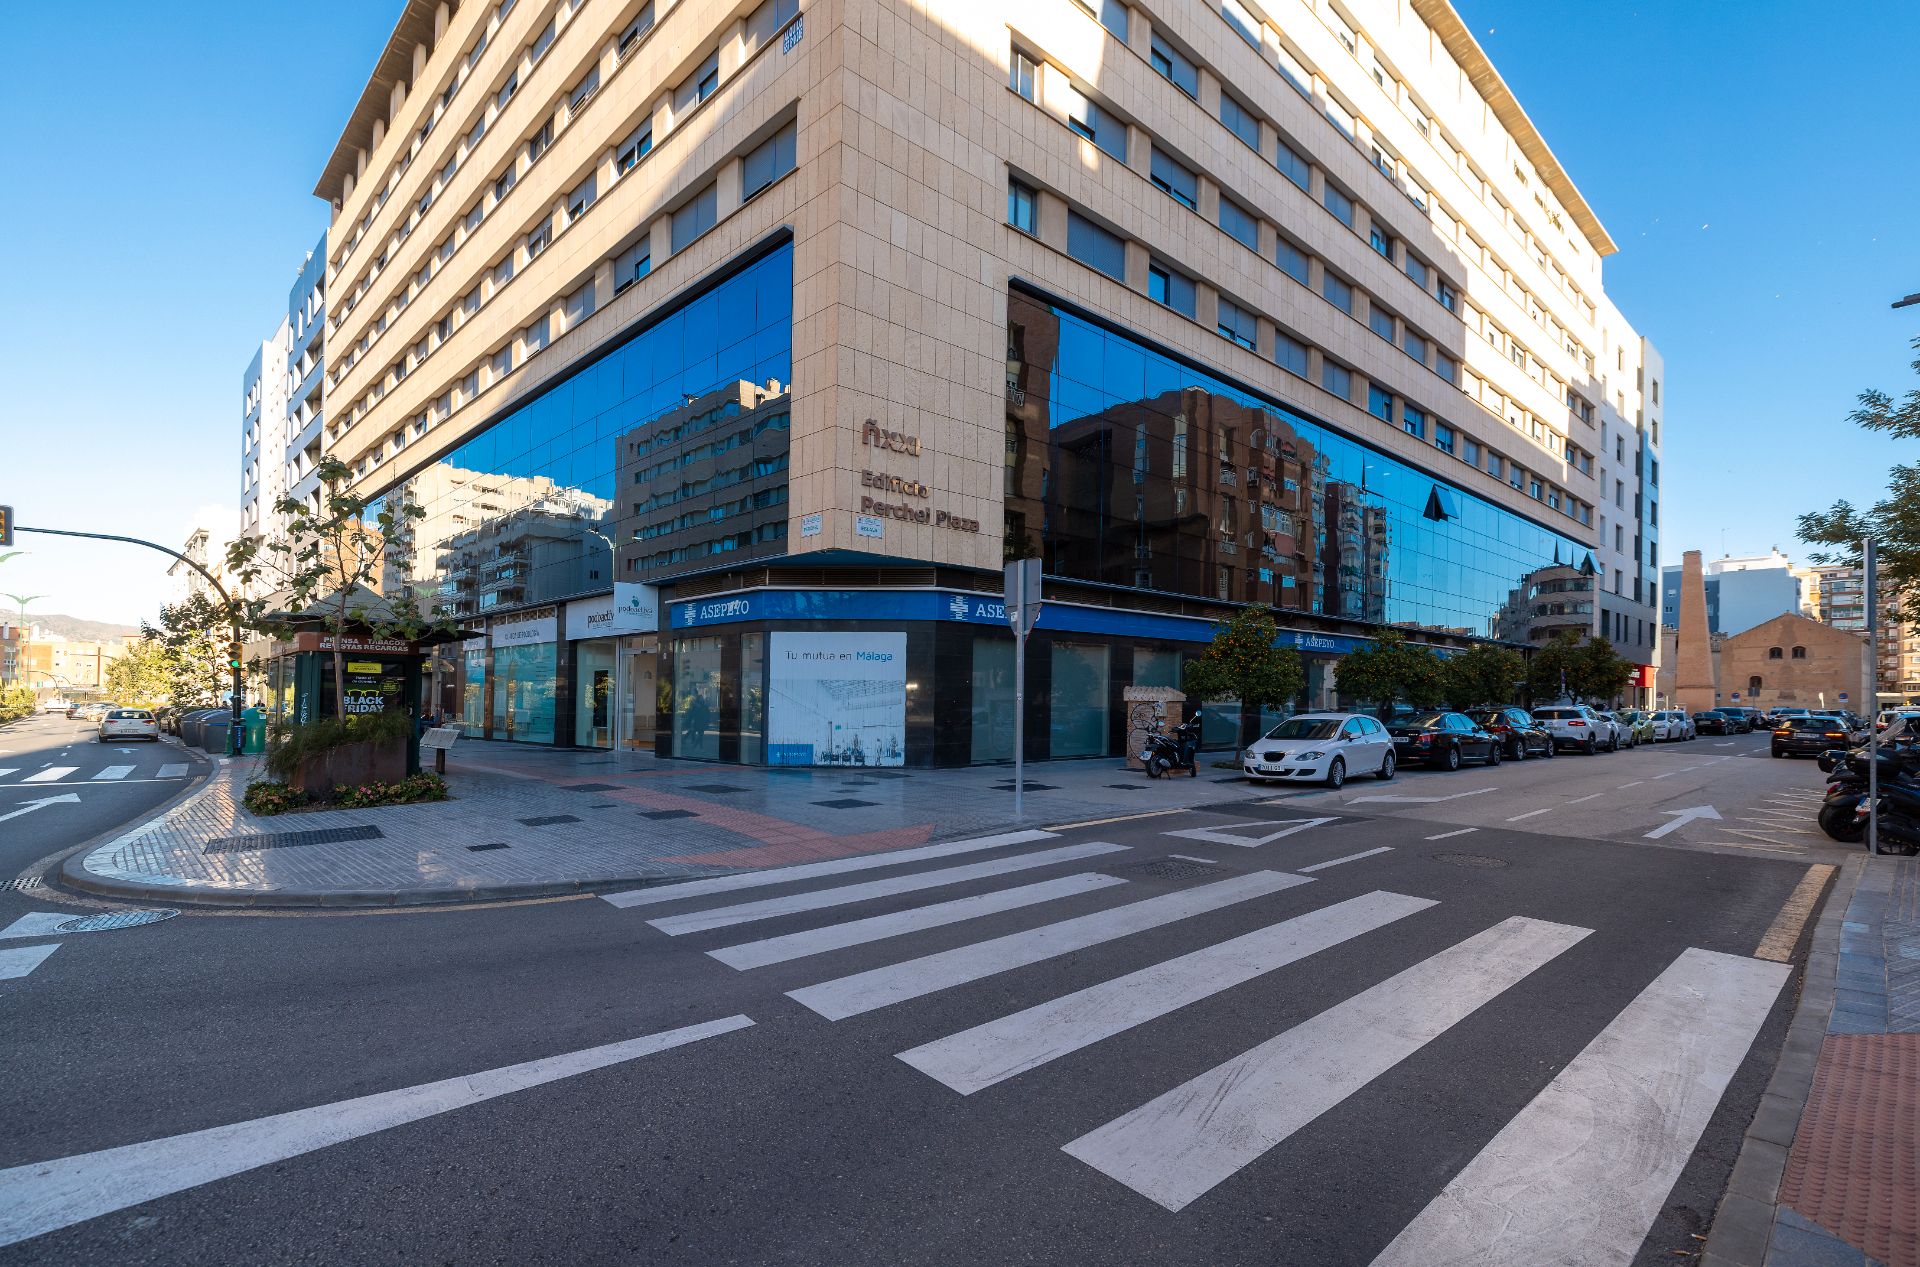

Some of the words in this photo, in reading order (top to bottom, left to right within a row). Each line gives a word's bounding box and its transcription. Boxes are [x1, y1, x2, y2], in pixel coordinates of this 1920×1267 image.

[861, 469, 929, 498] Edificio
[861, 496, 931, 524] Perchel
[935, 509, 980, 532] Plaza
[700, 600, 749, 619] ASEPEYO
[319, 642, 362, 650] RESTAS
[363, 644, 409, 652] RECARGAS
[323, 636, 359, 644] PRNSA
[367, 638, 406, 646] TABACOS
[1306, 637, 1335, 649] ASEPEYO
[785, 650, 798, 660] Tu
[802, 651, 835, 660] mutua
[840, 652, 852, 660] en
[856, 651, 893, 663] Málaga
[343, 696, 384, 705] BLACK
